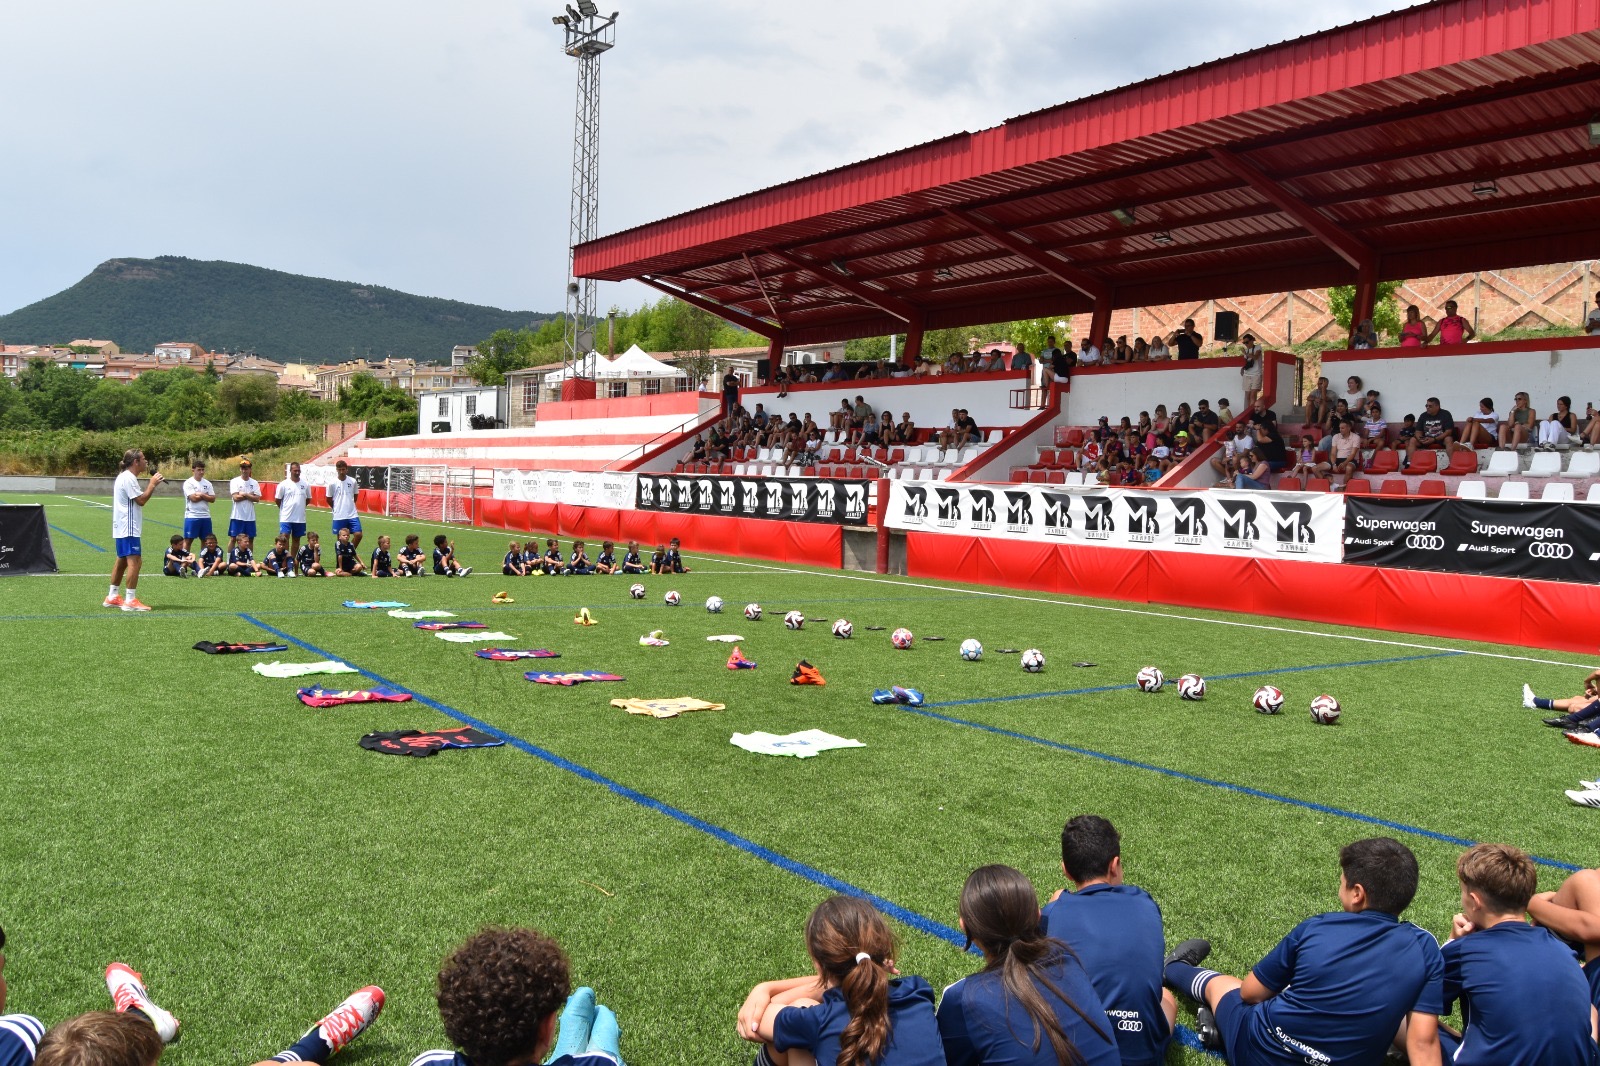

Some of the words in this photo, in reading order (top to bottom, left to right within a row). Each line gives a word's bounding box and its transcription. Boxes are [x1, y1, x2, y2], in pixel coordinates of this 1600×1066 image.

[1355, 516, 1436, 533] Superwagen
[1471, 520, 1564, 540] Superwagen
[1373, 538, 1394, 546] Sport
[1490, 545, 1516, 554] Sport
[1275, 1026, 1332, 1063] Superwagen
